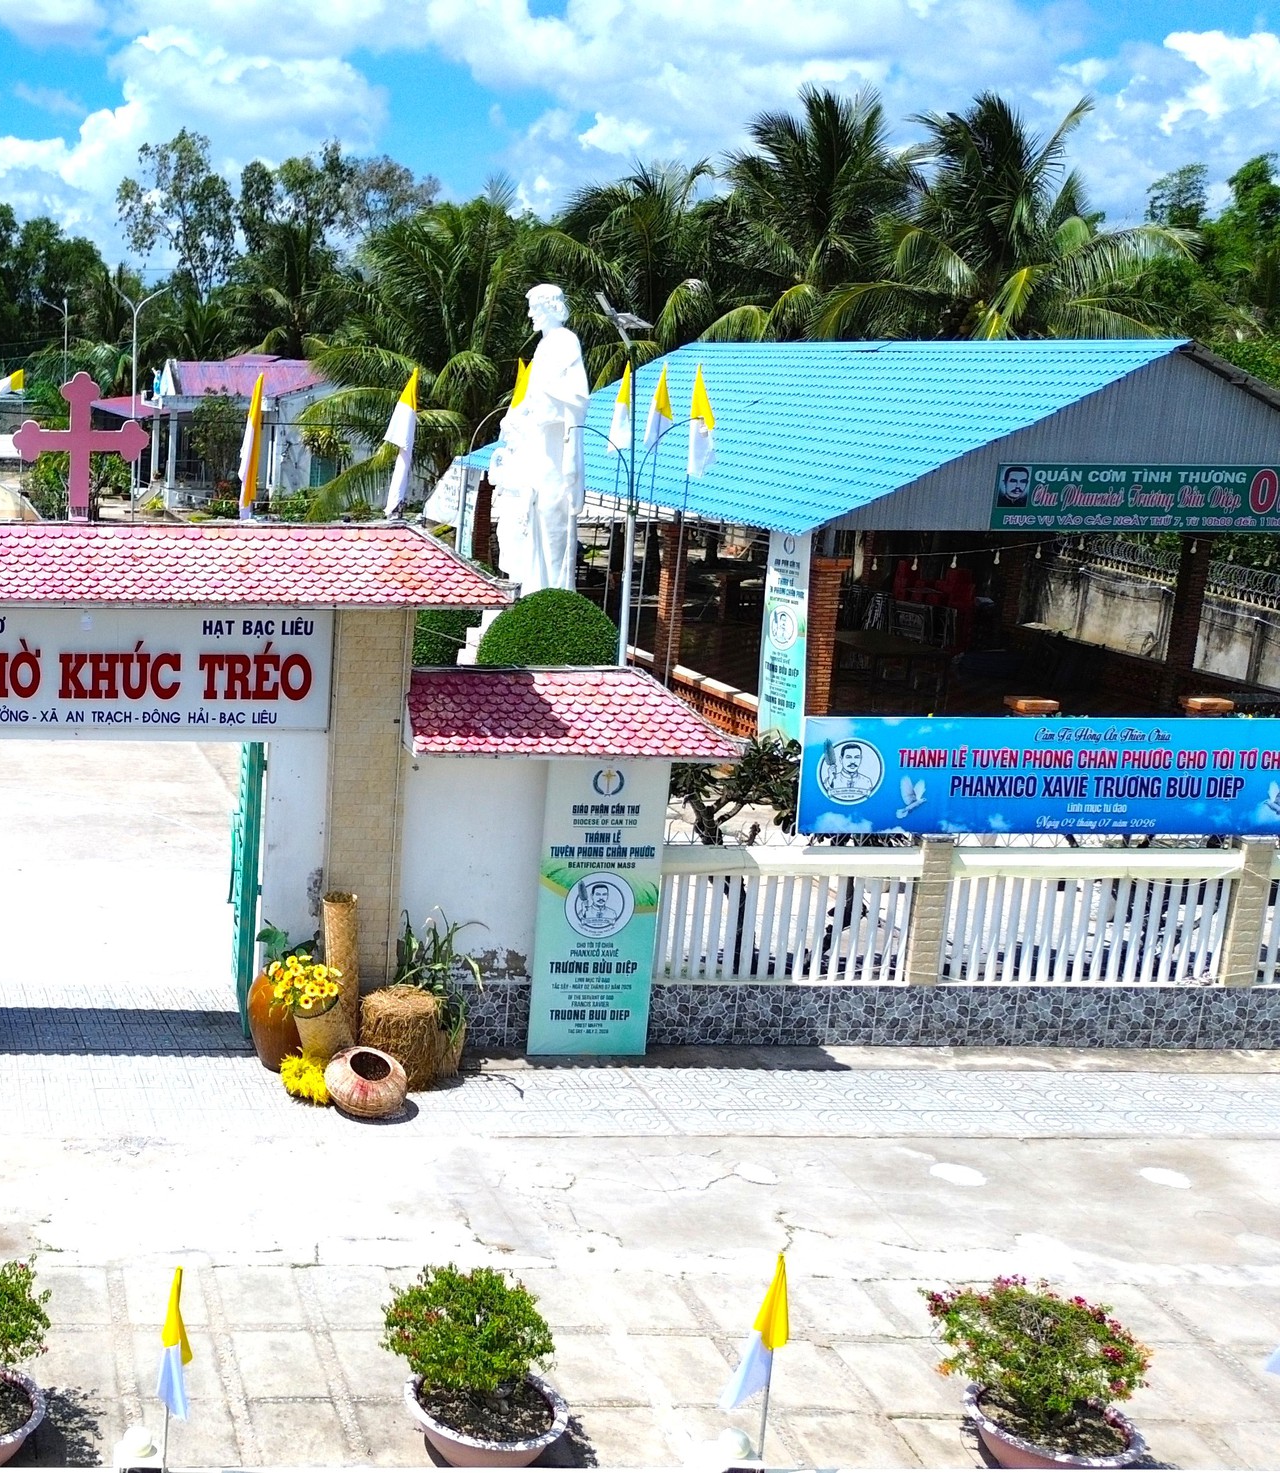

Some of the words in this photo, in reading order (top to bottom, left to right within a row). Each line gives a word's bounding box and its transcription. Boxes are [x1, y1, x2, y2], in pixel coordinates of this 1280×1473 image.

[1035, 468, 1082, 483] QUÁN
[1088, 470, 1126, 482] CƠM
[1132, 469, 1172, 483] TÌNH
[1178, 470, 1247, 483] THƯƠNG
[1003, 515, 1036, 526] PHỤC
[1037, 515, 1055, 526] VỤ
[1057, 514, 1083, 525] VÀO
[1084, 514, 1112, 526] CÁC
[1113, 514, 1148, 526] NGÀY
[202, 620, 235, 639] HẠT
[242, 620, 275, 639] BẠC
[281, 617, 314, 636] LIÊU
[59, 641, 181, 700] KHÚC
[199, 641, 312, 701] TRÉO
[40, 708, 59, 722] XÃ
[66, 711, 84, 722] AN
[92, 711, 132, 725] TRẠCH
[142, 709, 180, 723] ĐÔNG
[188, 708, 209, 723] HẢI
[220, 712, 245, 726] BẠC
[252, 710, 277, 724] LIÊU
[899, 747, 948, 768] THÁNH
[952, 745, 967, 768] LỄ
[972, 747, 1018, 768] TUYÊN
[1022, 750, 1073, 768] PHONG
[1078, 748, 1118, 769] CHÂN
[1122, 749, 1172, 769] PHƯỚC
[1177, 751, 1207, 769] CHO
[1212, 748, 1234, 769] TÔI
[1239, 748, 1258, 769] TỚ
[950, 773, 1037, 797] PHANXICÔ
[1042, 774, 1088, 797] XAVIÊ
[1094, 775, 1162, 798] TRƯƠNG
[1166, 772, 1202, 798] BỬU
[1206, 774, 1244, 802] DIỆP
[572, 804, 588, 814] GIÁO
[590, 804, 609, 817] PHẬN
[627, 804, 640, 814] THƠ
[1067, 802, 1082, 813] Linh
[1084, 804, 1102, 814] mục
[1061, 819, 1075, 827] 02
[1098, 819, 1111, 827] 07
[1130, 819, 1156, 828] 2026
[585, 830, 610, 843] THÁNH
[551, 845, 575, 857] TUYÊN
[577, 847, 604, 857] PHONG
[606, 845, 627, 857] CHÂN
[630, 845, 655, 857] PHƯỚC
[550, 960, 589, 973] TRƯƠNG
[592, 958, 612, 973] BỬU
[616, 960, 638, 976] DIỆP
[550, 1010, 586, 1020] TRUONG
[589, 1010, 607, 1020] BUU
[610, 1010, 630, 1020] DIEP
